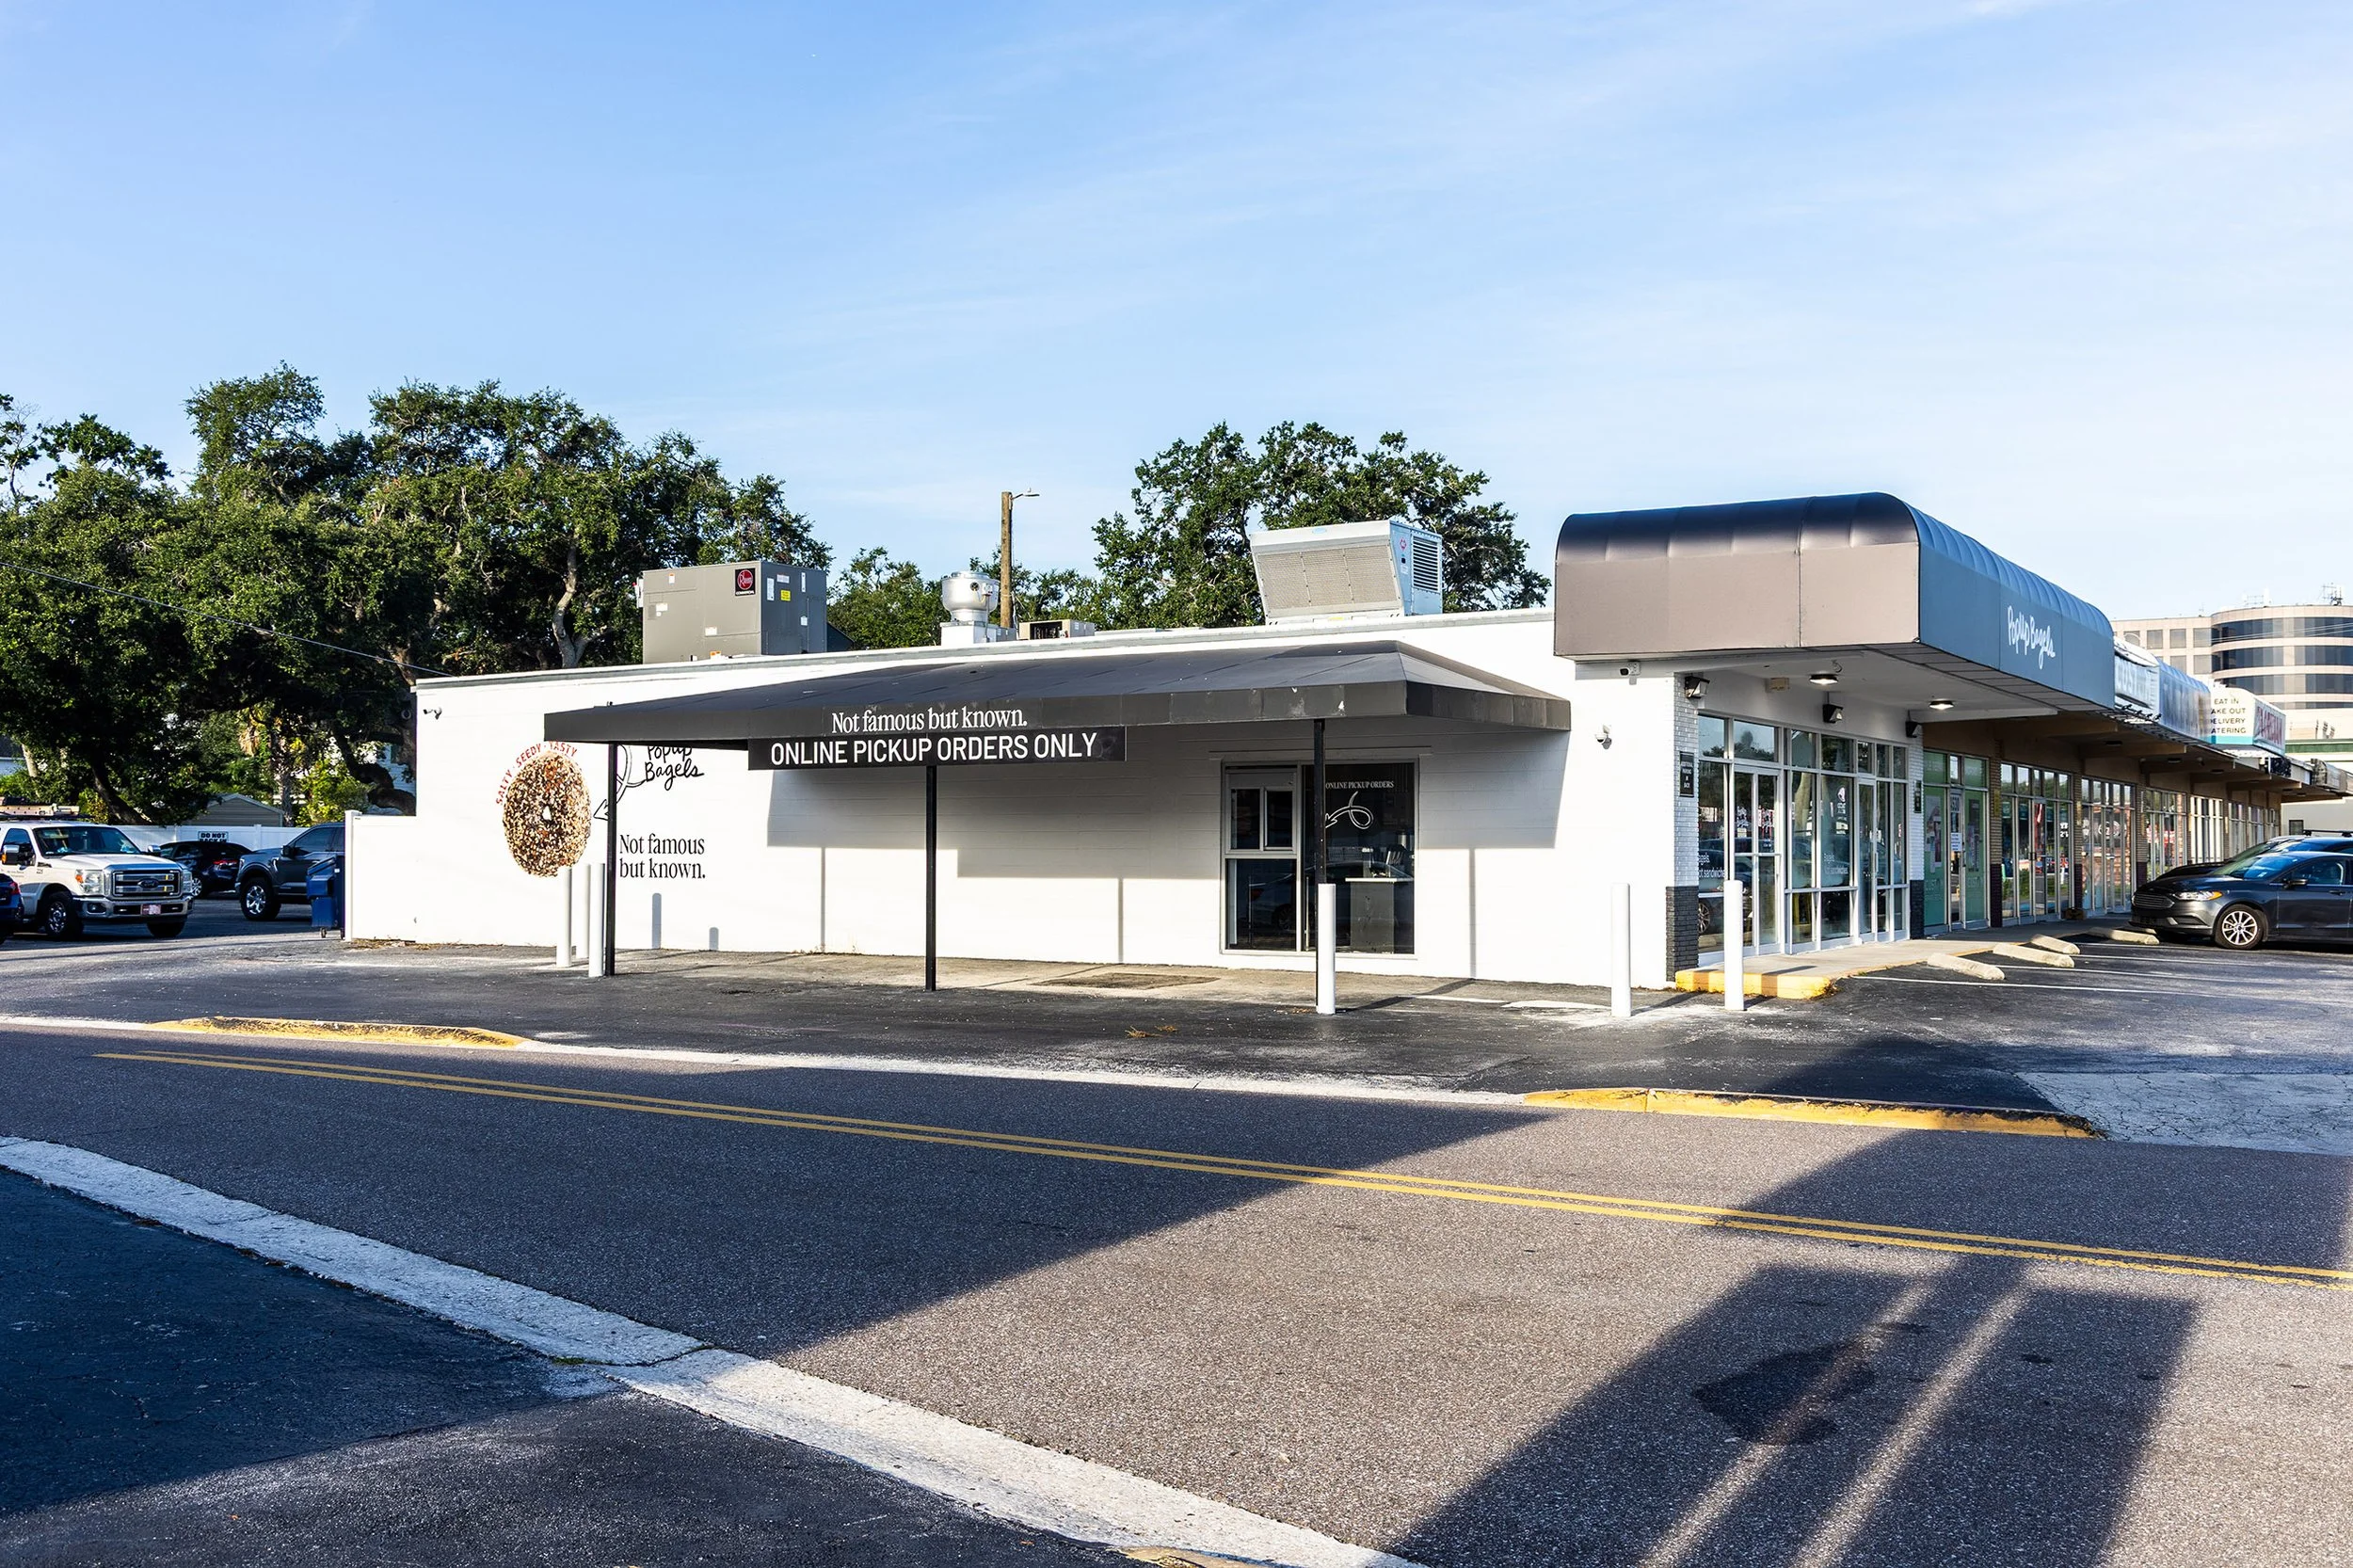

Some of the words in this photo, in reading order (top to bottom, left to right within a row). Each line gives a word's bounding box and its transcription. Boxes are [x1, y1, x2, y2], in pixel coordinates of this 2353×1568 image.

[832, 712, 860, 734] Not
[862, 709, 925, 732] famous
[927, 707, 959, 729] but
[961, 705, 1028, 728] known.
[771, 741, 848, 765] ONLINE
[853, 737, 933, 763] PICKUP
[936, 734, 1029, 761] ORDERS
[1033, 731, 1098, 759] ONLY
[496, 769, 512, 805] SALTY
[515, 743, 541, 768] SEEDY
[549, 741, 577, 757] TASTY
[645, 758, 705, 792] Bagels
[1325, 781, 1348, 790] ONLINE
[1348, 780, 1369, 789] PICKUP
[1370, 780, 1394, 789] ORDERS
[619, 834, 645, 855] Not
[648, 832, 705, 855] famous
[619, 857, 645, 878] but
[648, 857, 706, 879] known.
